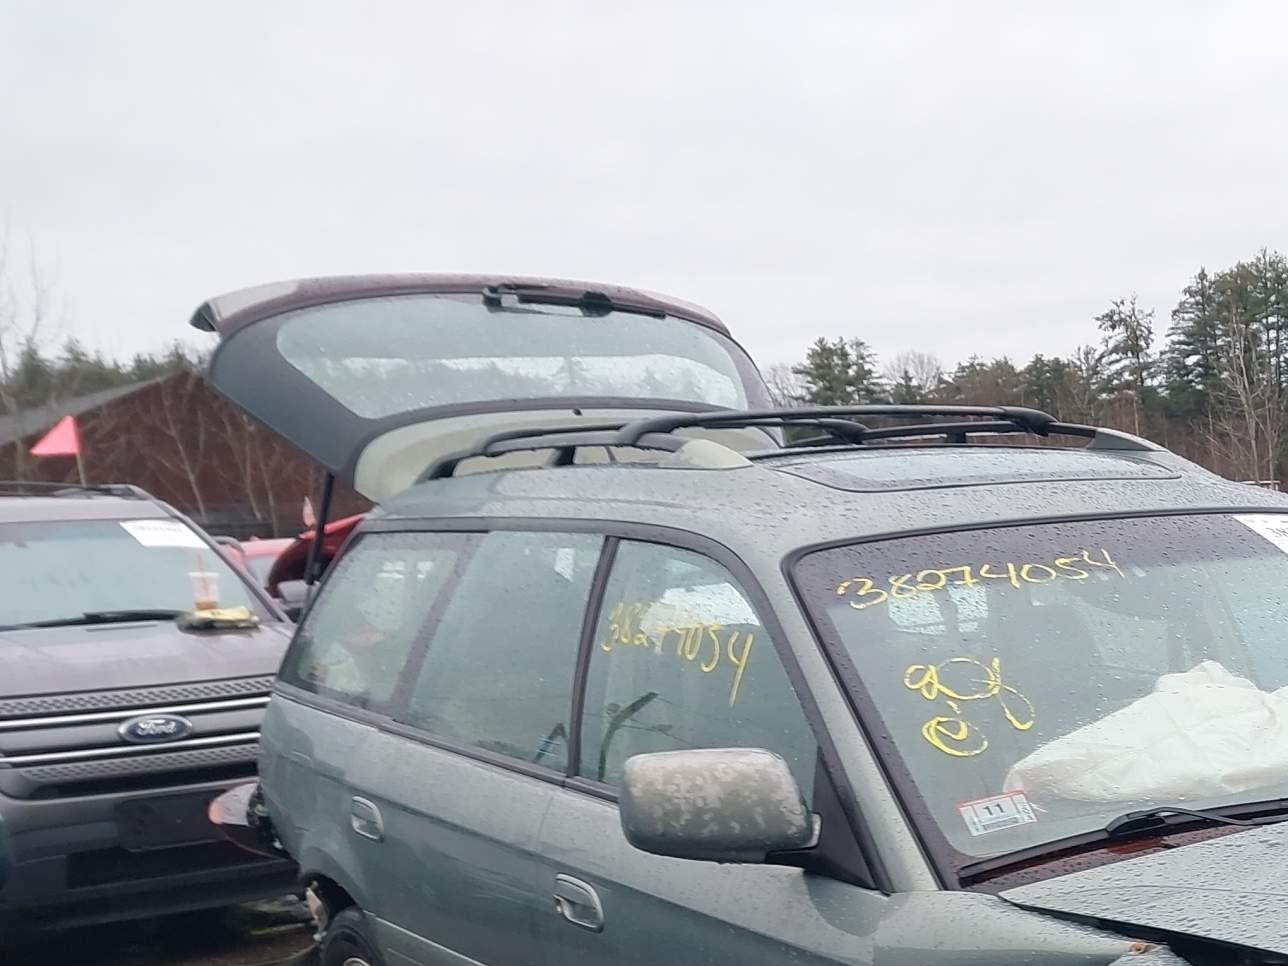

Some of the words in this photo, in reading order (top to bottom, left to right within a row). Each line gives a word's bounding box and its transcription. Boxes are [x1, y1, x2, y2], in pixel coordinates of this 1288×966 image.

[836, 548, 1124, 610] 38274054
[135, 719, 176, 737] Ford
[982, 803, 1005, 817] 11
